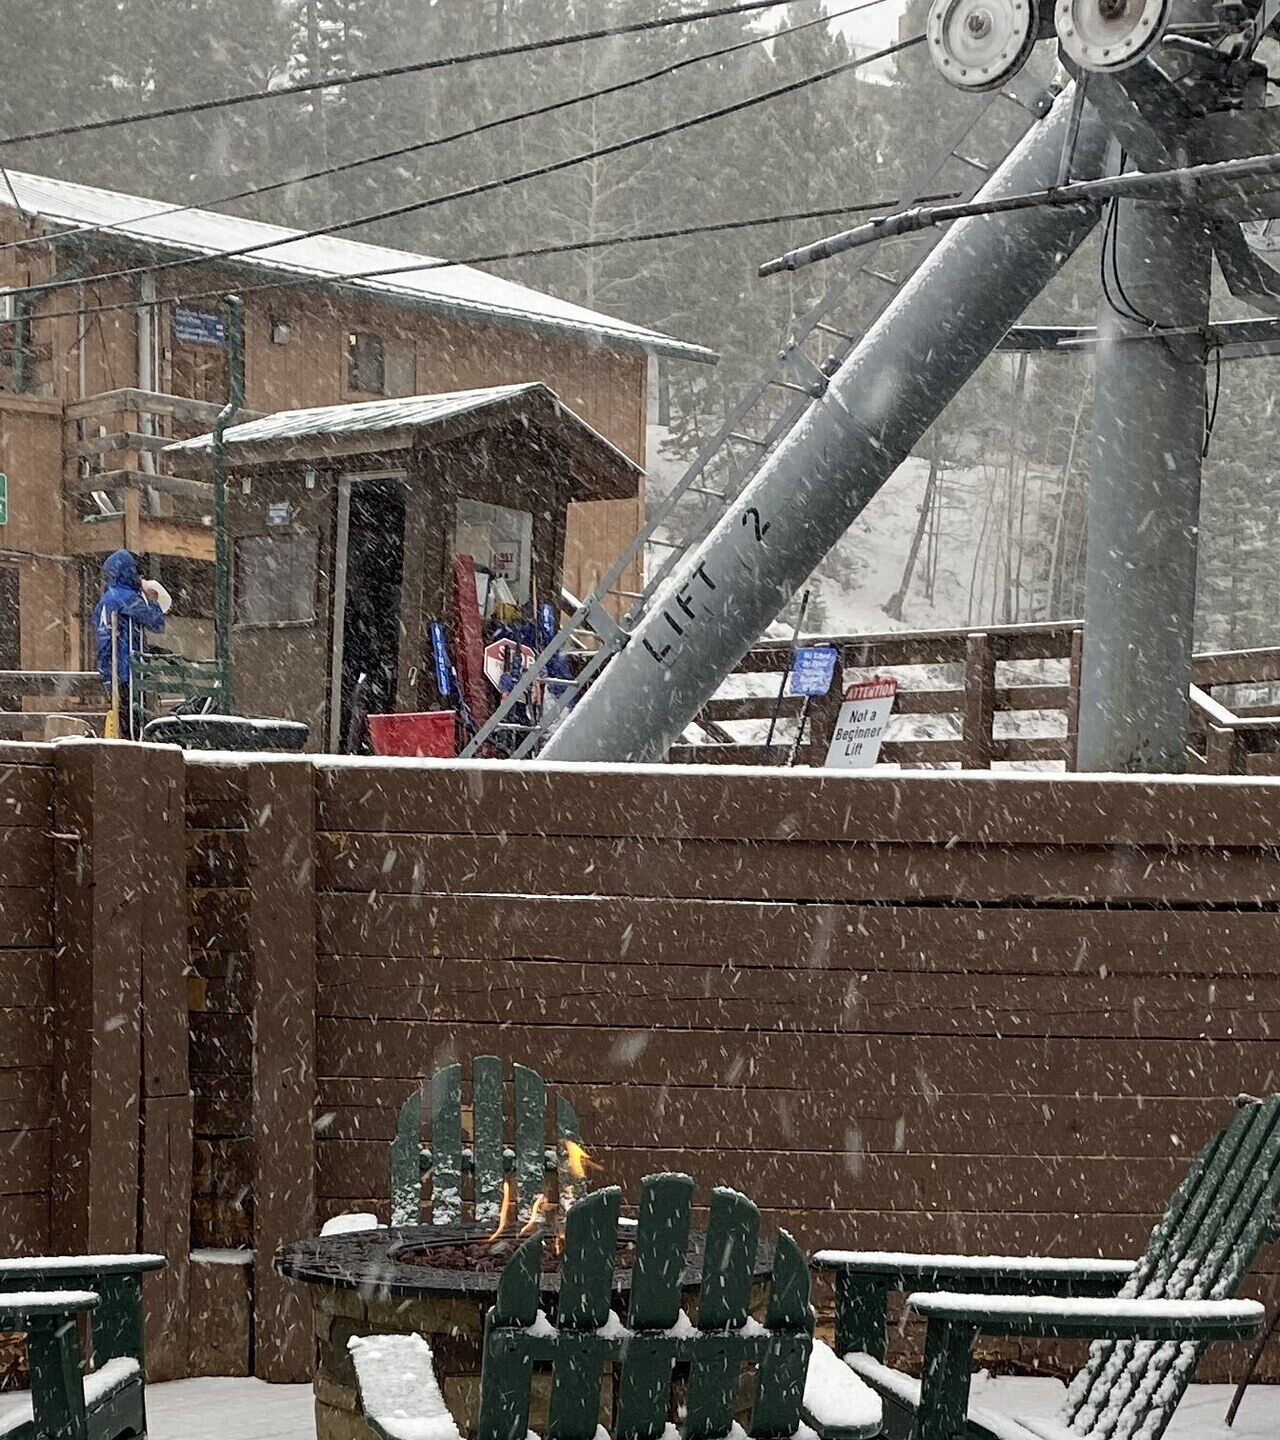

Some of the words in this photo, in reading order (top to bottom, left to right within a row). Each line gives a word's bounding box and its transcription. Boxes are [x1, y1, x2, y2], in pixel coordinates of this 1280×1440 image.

[741, 507, 771, 542] 2
[642, 560, 716, 664] LIFT
[845, 682, 896, 701] ATTENTION
[848, 710, 869, 723] Not
[869, 711, 877, 722] a
[835, 726, 883, 742] Beginner
[844, 743, 863, 757] Lift
